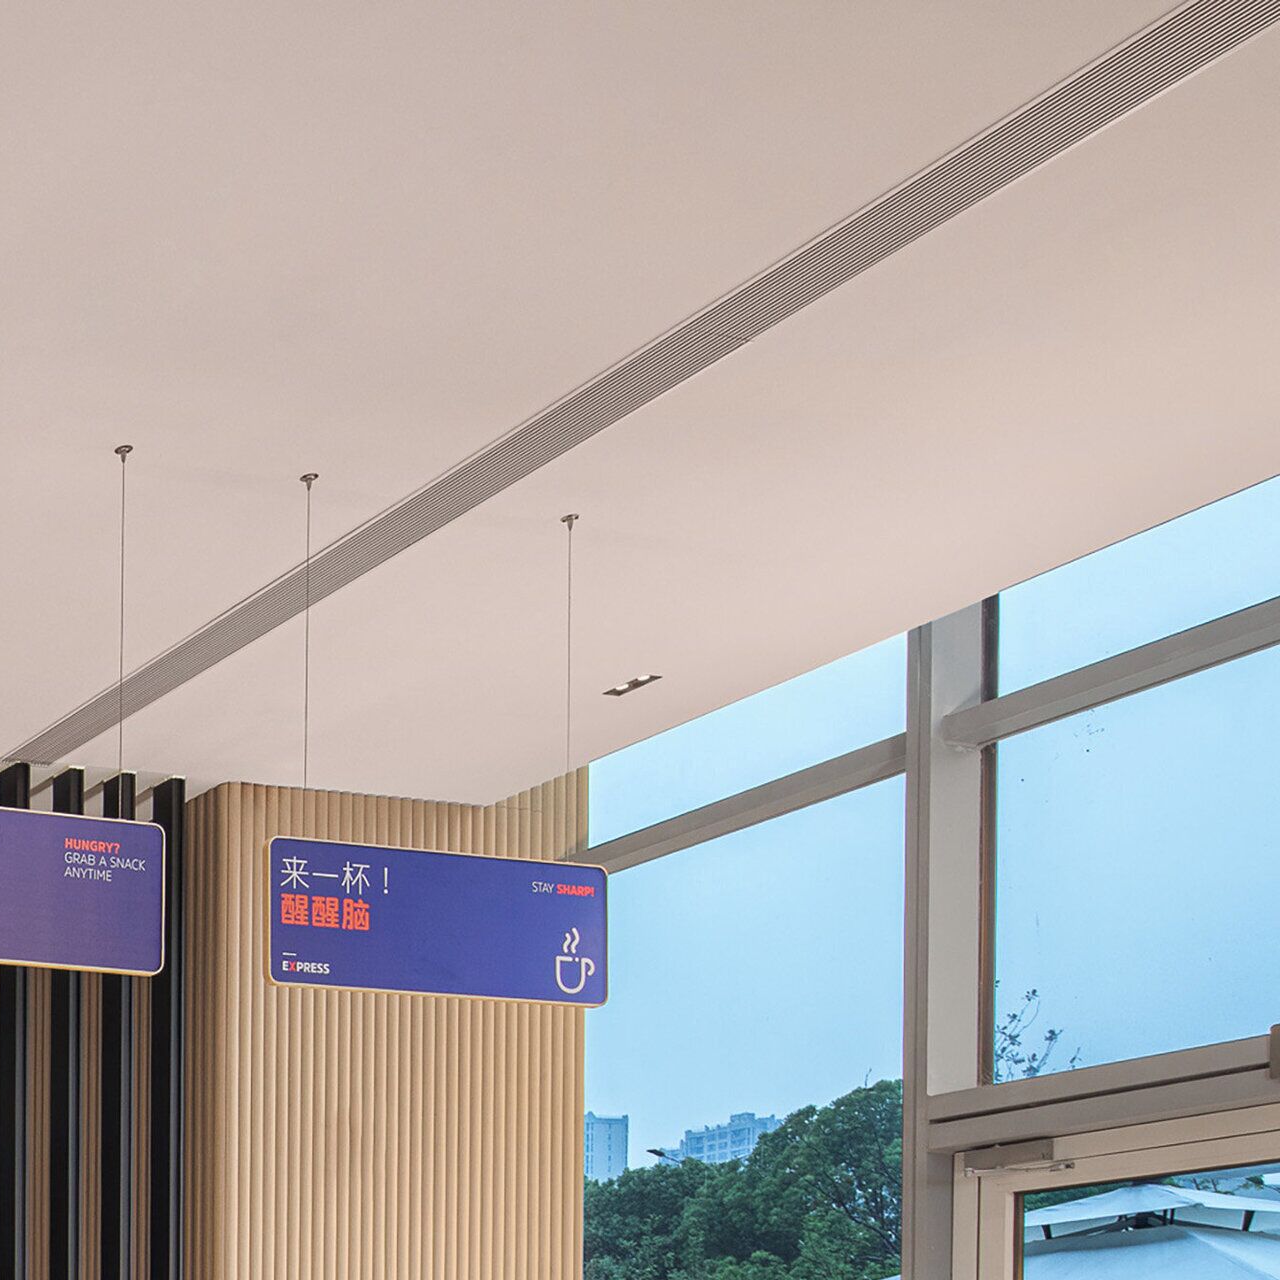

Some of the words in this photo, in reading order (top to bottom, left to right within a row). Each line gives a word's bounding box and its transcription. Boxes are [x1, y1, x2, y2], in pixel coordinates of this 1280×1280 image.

[64, 838, 120, 854] HUNGRY?
[64, 852, 96, 866] GRAB
[98, 856, 107, 867] A
[109, 856, 146, 872] SNACK
[64, 866, 112, 882] ANYTIME
[532, 881, 554, 893] STAY
[280, 893, 370, 931] 醒醒脑
[282, 960, 331, 975] EXPRESS
